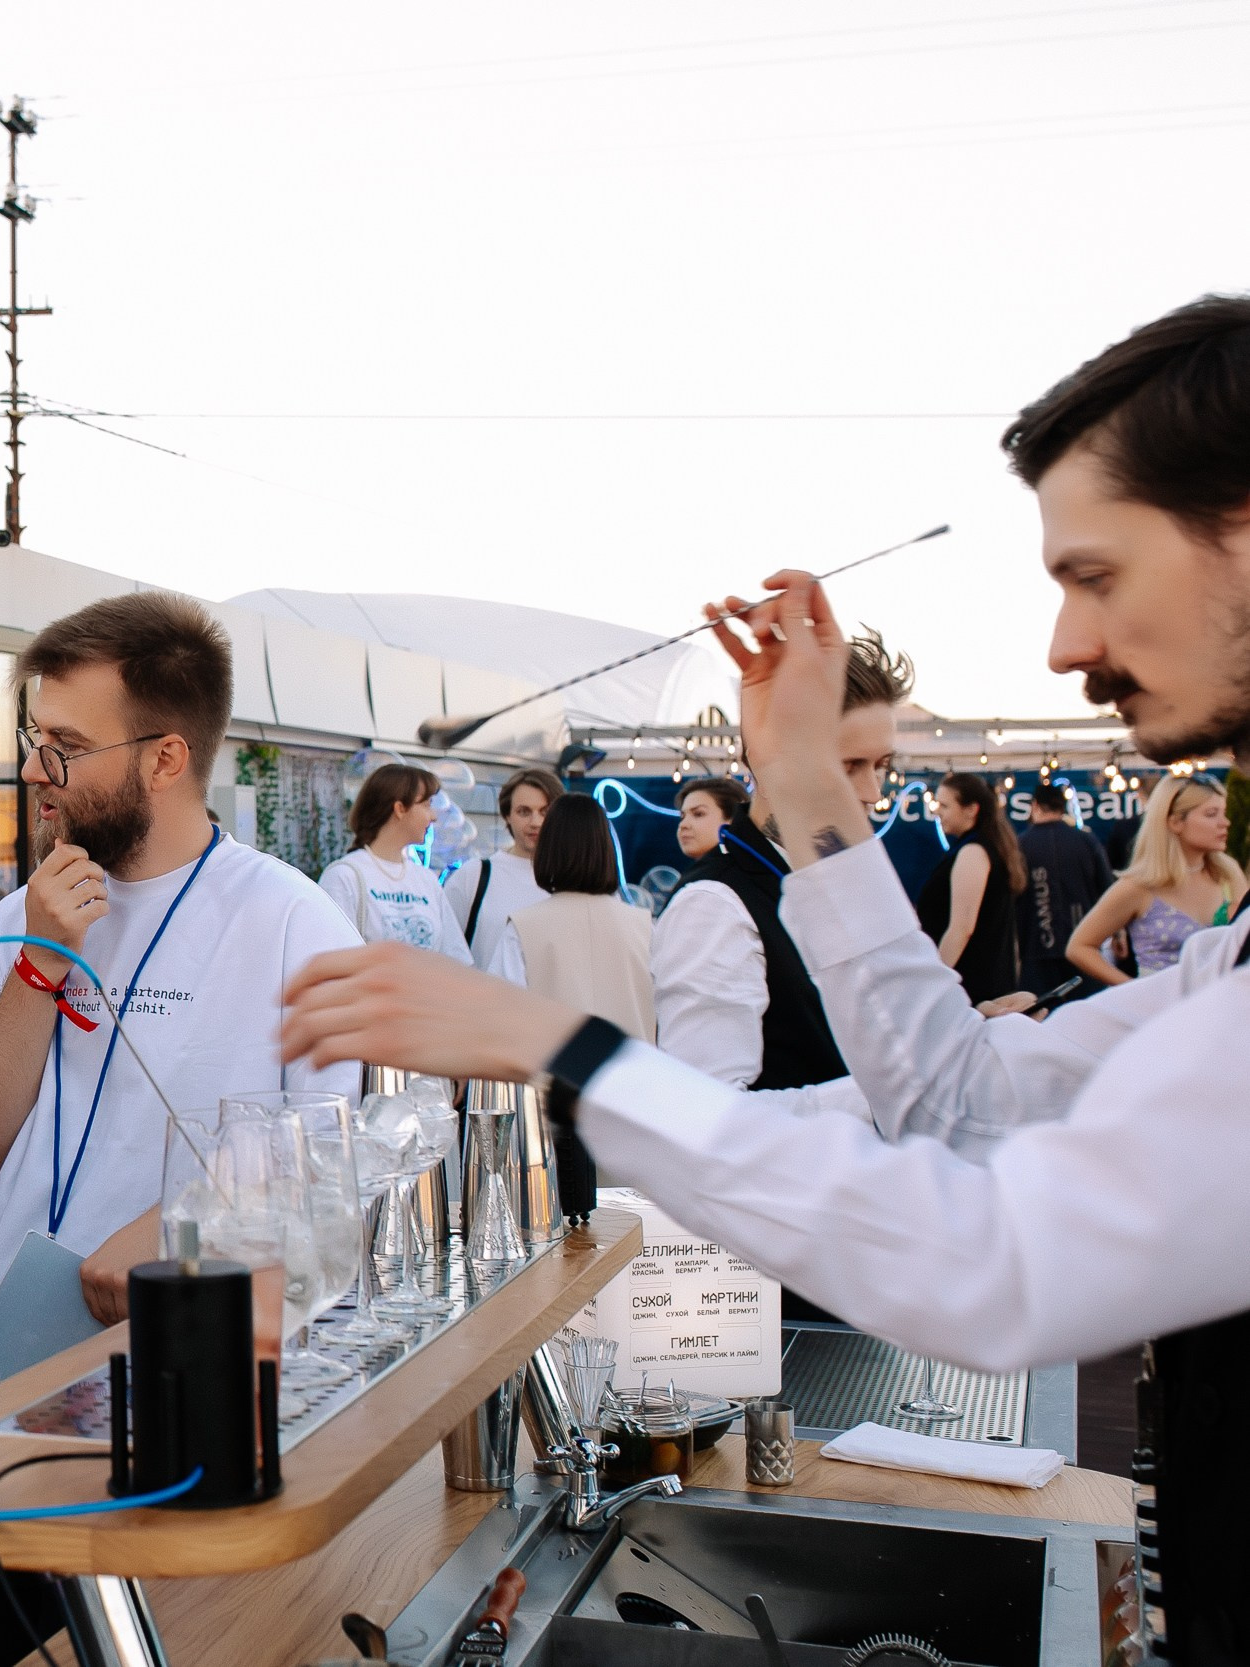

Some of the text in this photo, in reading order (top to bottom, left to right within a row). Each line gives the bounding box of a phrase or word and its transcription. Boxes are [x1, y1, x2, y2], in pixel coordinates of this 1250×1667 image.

[1032, 866, 1054, 949] CAMUS
[110, 988, 117, 996] a
[67, 1001, 171, 1016] ithout bulshit.
[635, 1243, 729, 1258] ЕЛЛИНИ-НЕГ
[674, 1259, 710, 1267] КАМПАРИ,
[675, 1266, 702, 1274] ВЕРМУТ
[632, 1291, 758, 1308] СУХОЙ МАРТИНИ
[665, 1309, 689, 1318] СУХОЙ
[696, 1308, 720, 1316] БЕЛЫЙ
[728, 1307, 758, 1315] ВЕРМУТ)
[670, 1335, 719, 1348] ГИМЛЕТ
[632, 1355, 658, 1364] (ДЖИН,
[659, 1352, 700, 1361] СЕЛЬДЕРЕЙ,
[701, 1351, 728, 1359] ПЕРСИК
[736, 1349, 759, 1357] ЛАЙМ)
